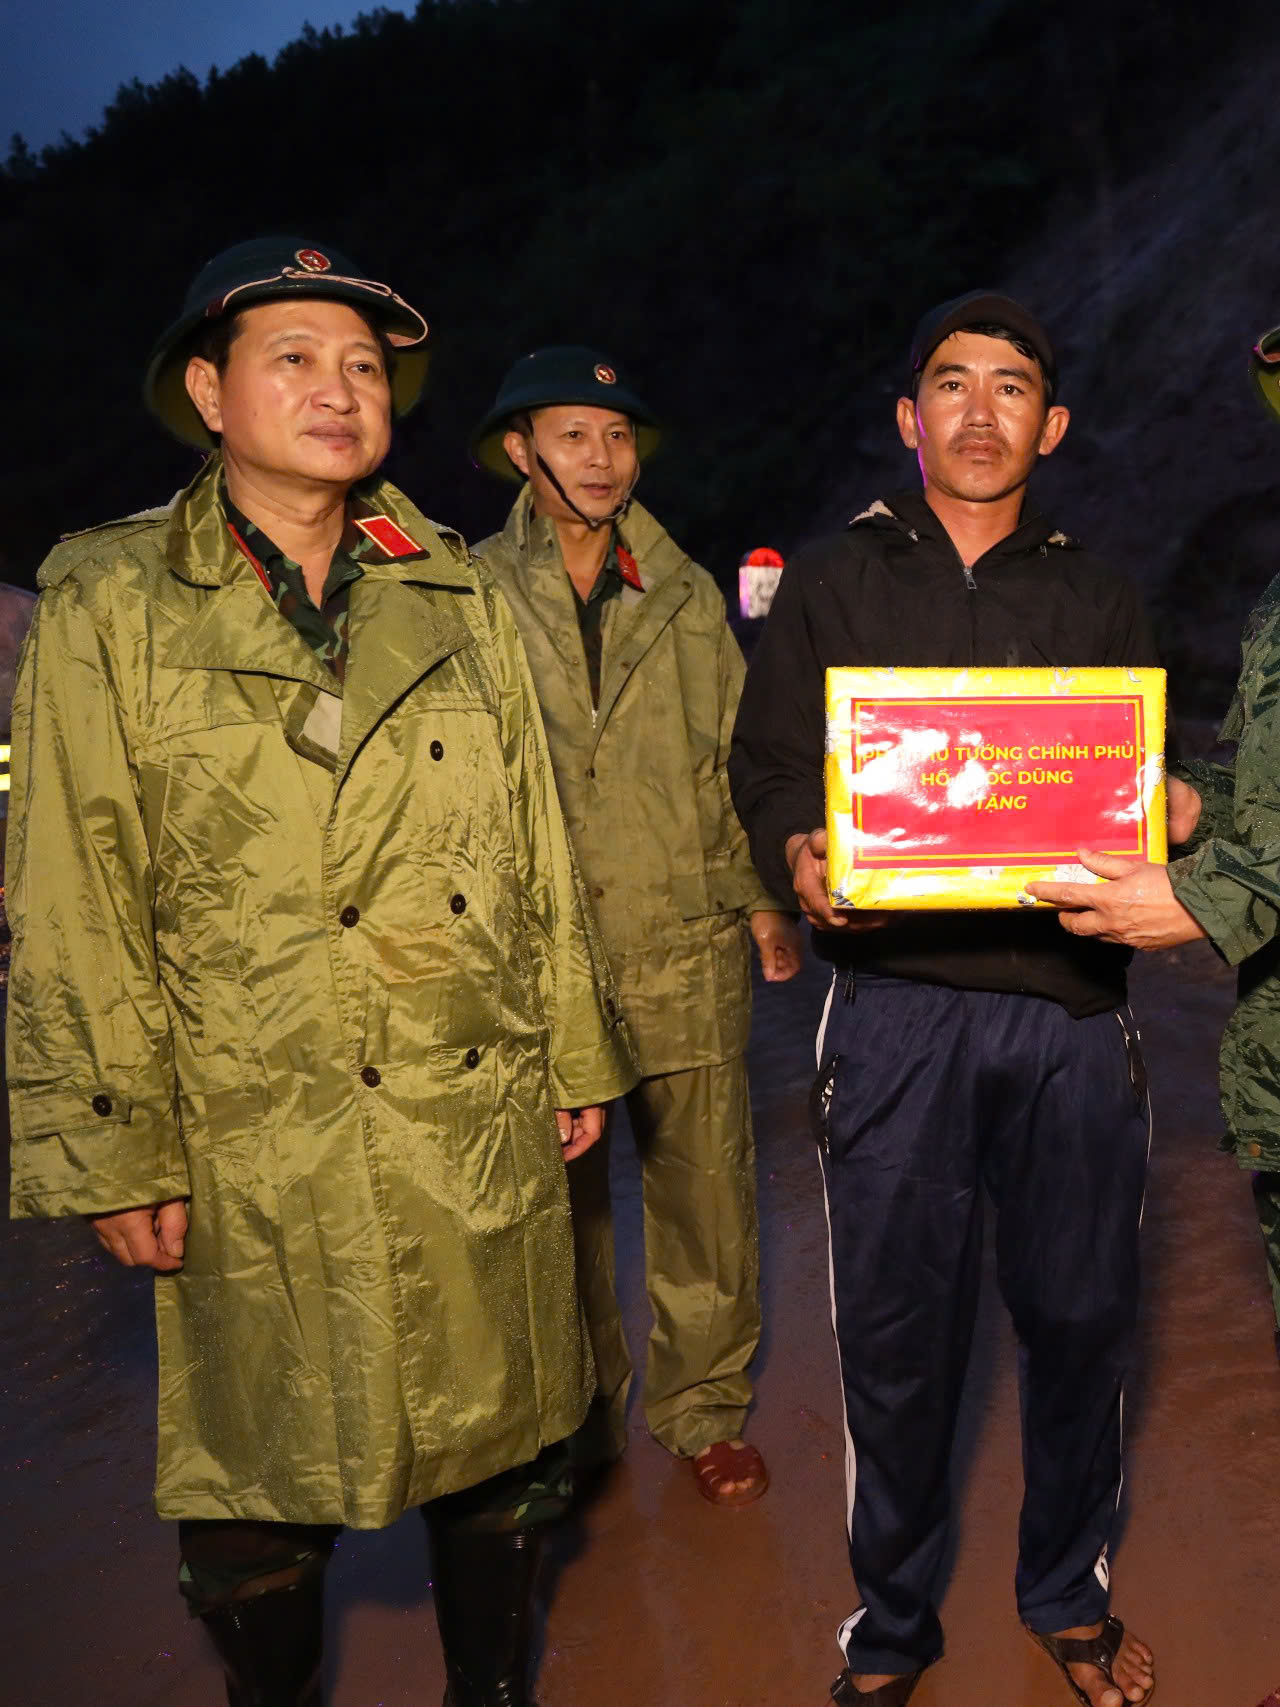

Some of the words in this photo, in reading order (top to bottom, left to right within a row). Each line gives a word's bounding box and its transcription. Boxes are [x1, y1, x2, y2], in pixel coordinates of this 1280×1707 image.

[1028, 742, 1089, 760] CHÍNH
[1094, 740, 1134, 759] PHỦ
[1018, 767, 1073, 785] DŨNG
